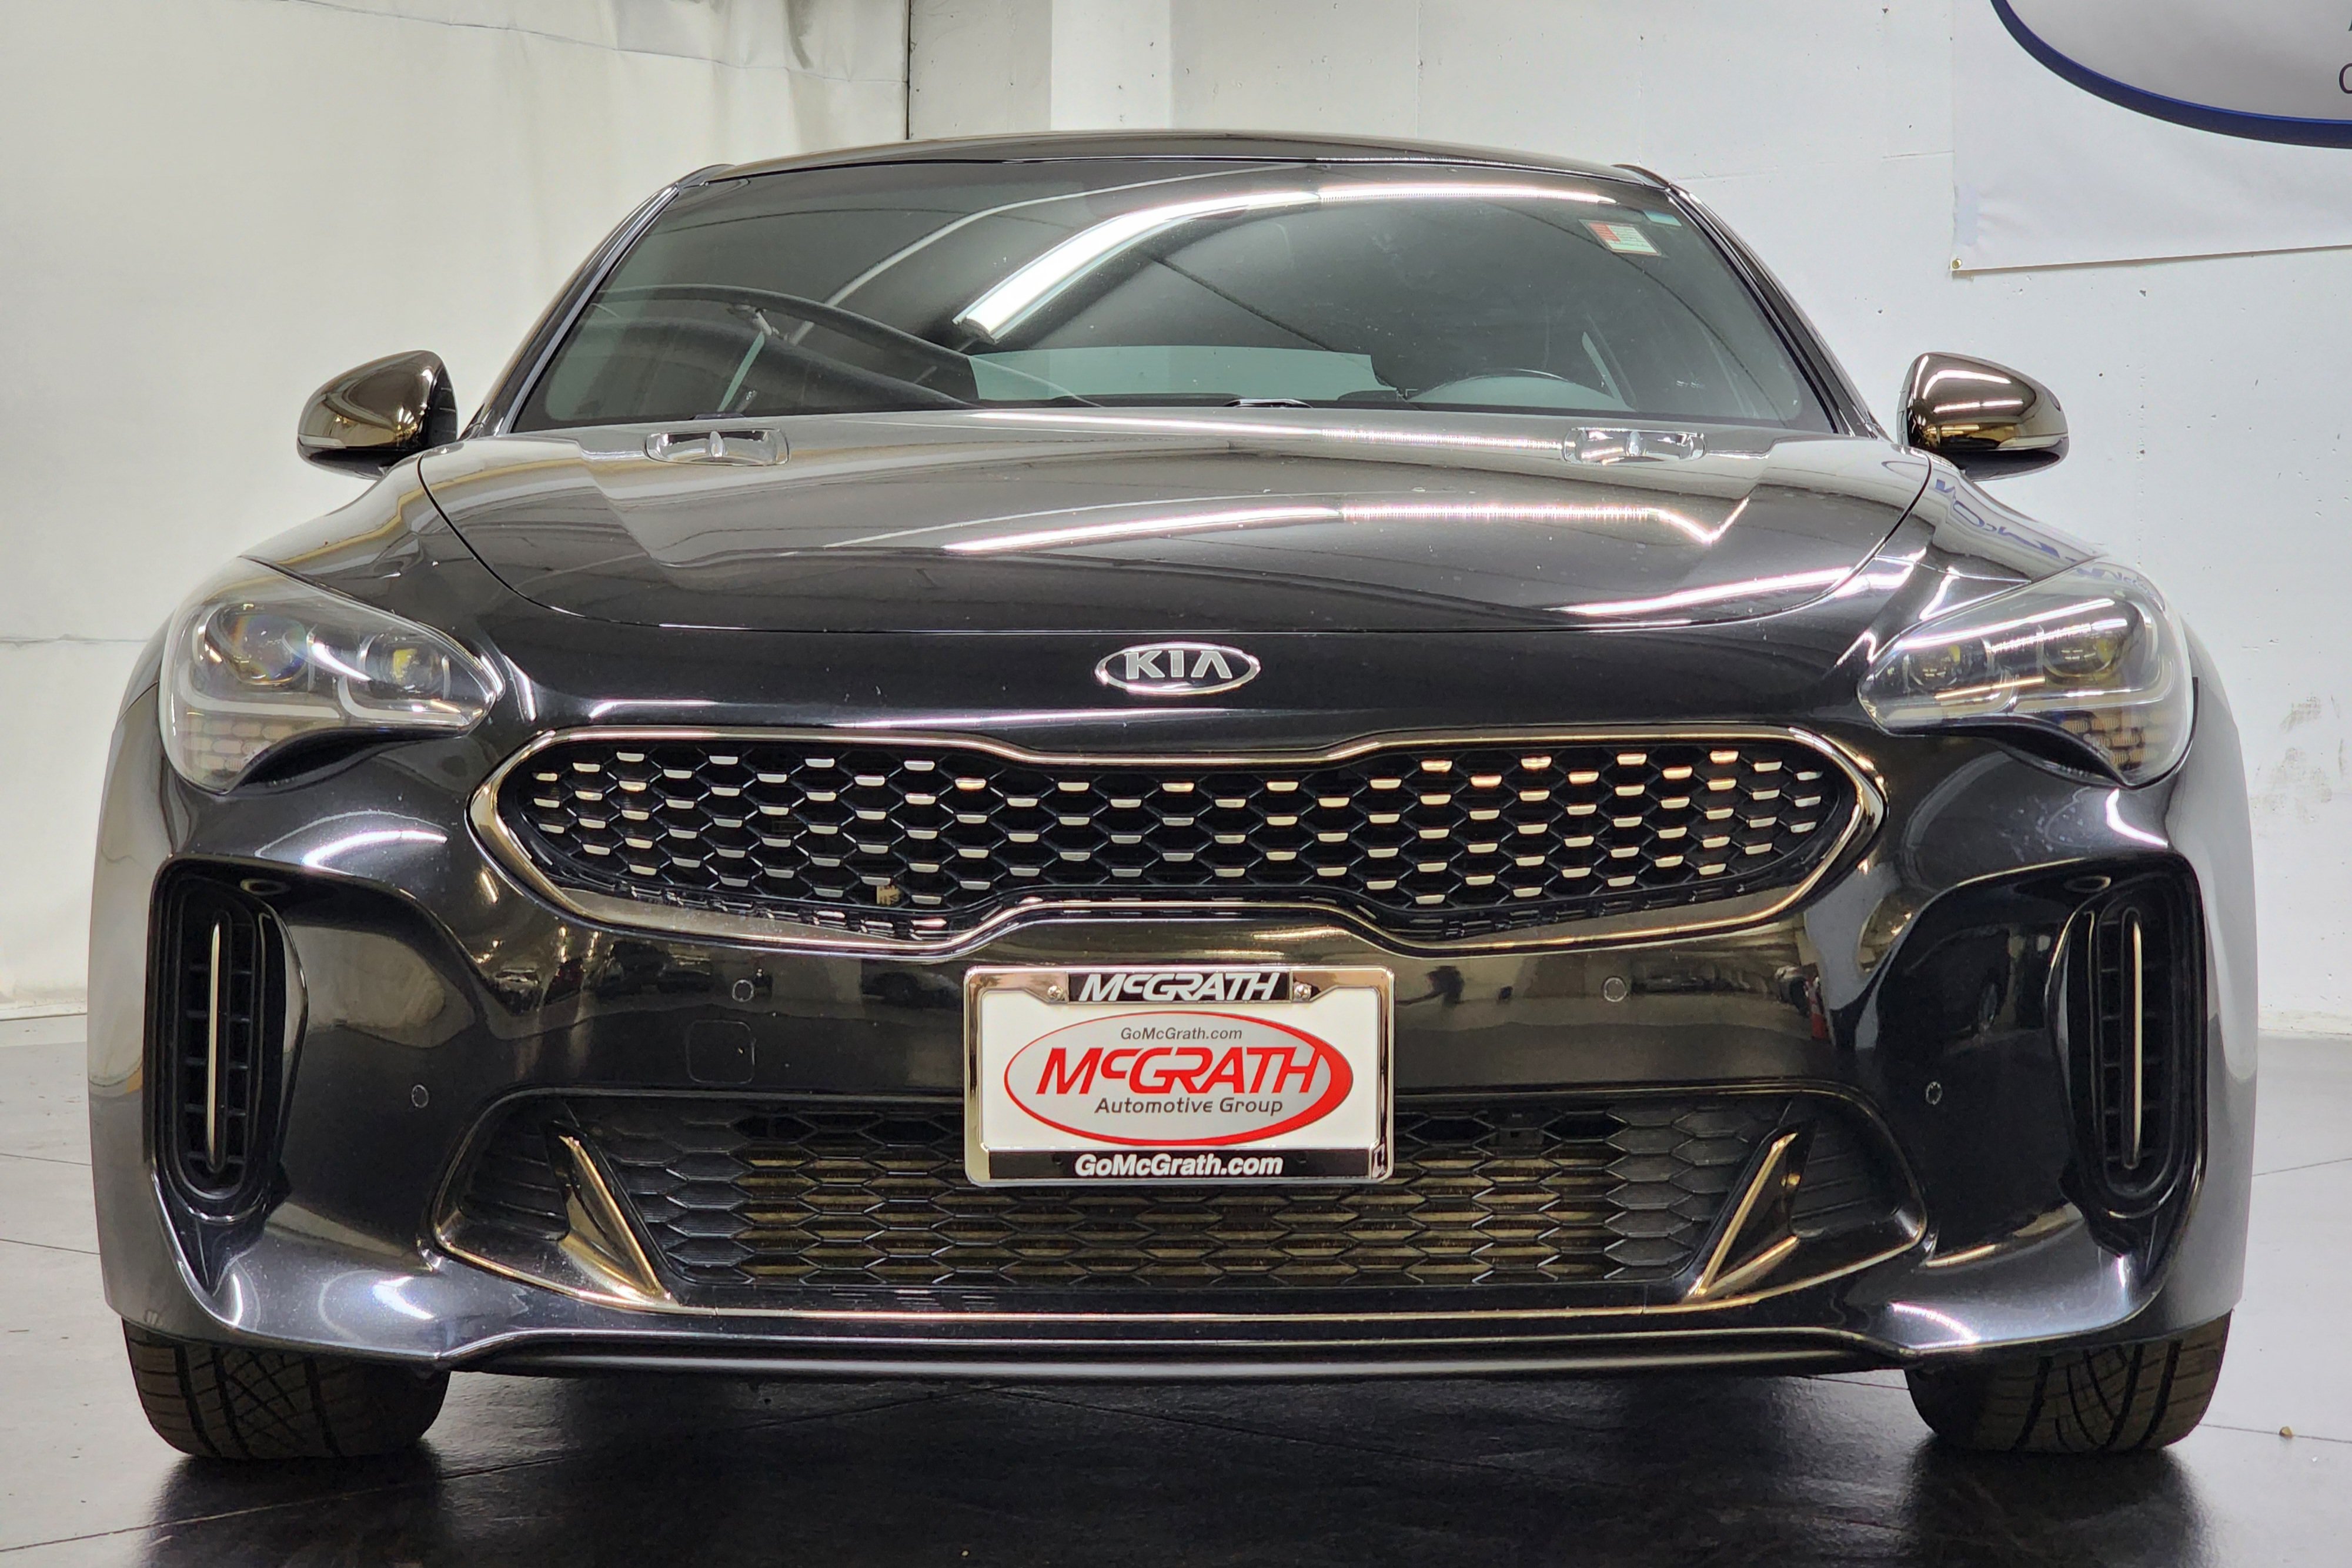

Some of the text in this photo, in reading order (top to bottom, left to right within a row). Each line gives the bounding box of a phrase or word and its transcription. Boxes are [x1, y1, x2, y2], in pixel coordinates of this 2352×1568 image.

[1124, 650, 1232, 680] KIA
[1120, 1027, 1242, 1040] GoMcGrath.com
[1094, 1097, 1283, 1116] Automotive Group
[1075, 1153, 1284, 1176] GoMcGrath.com
